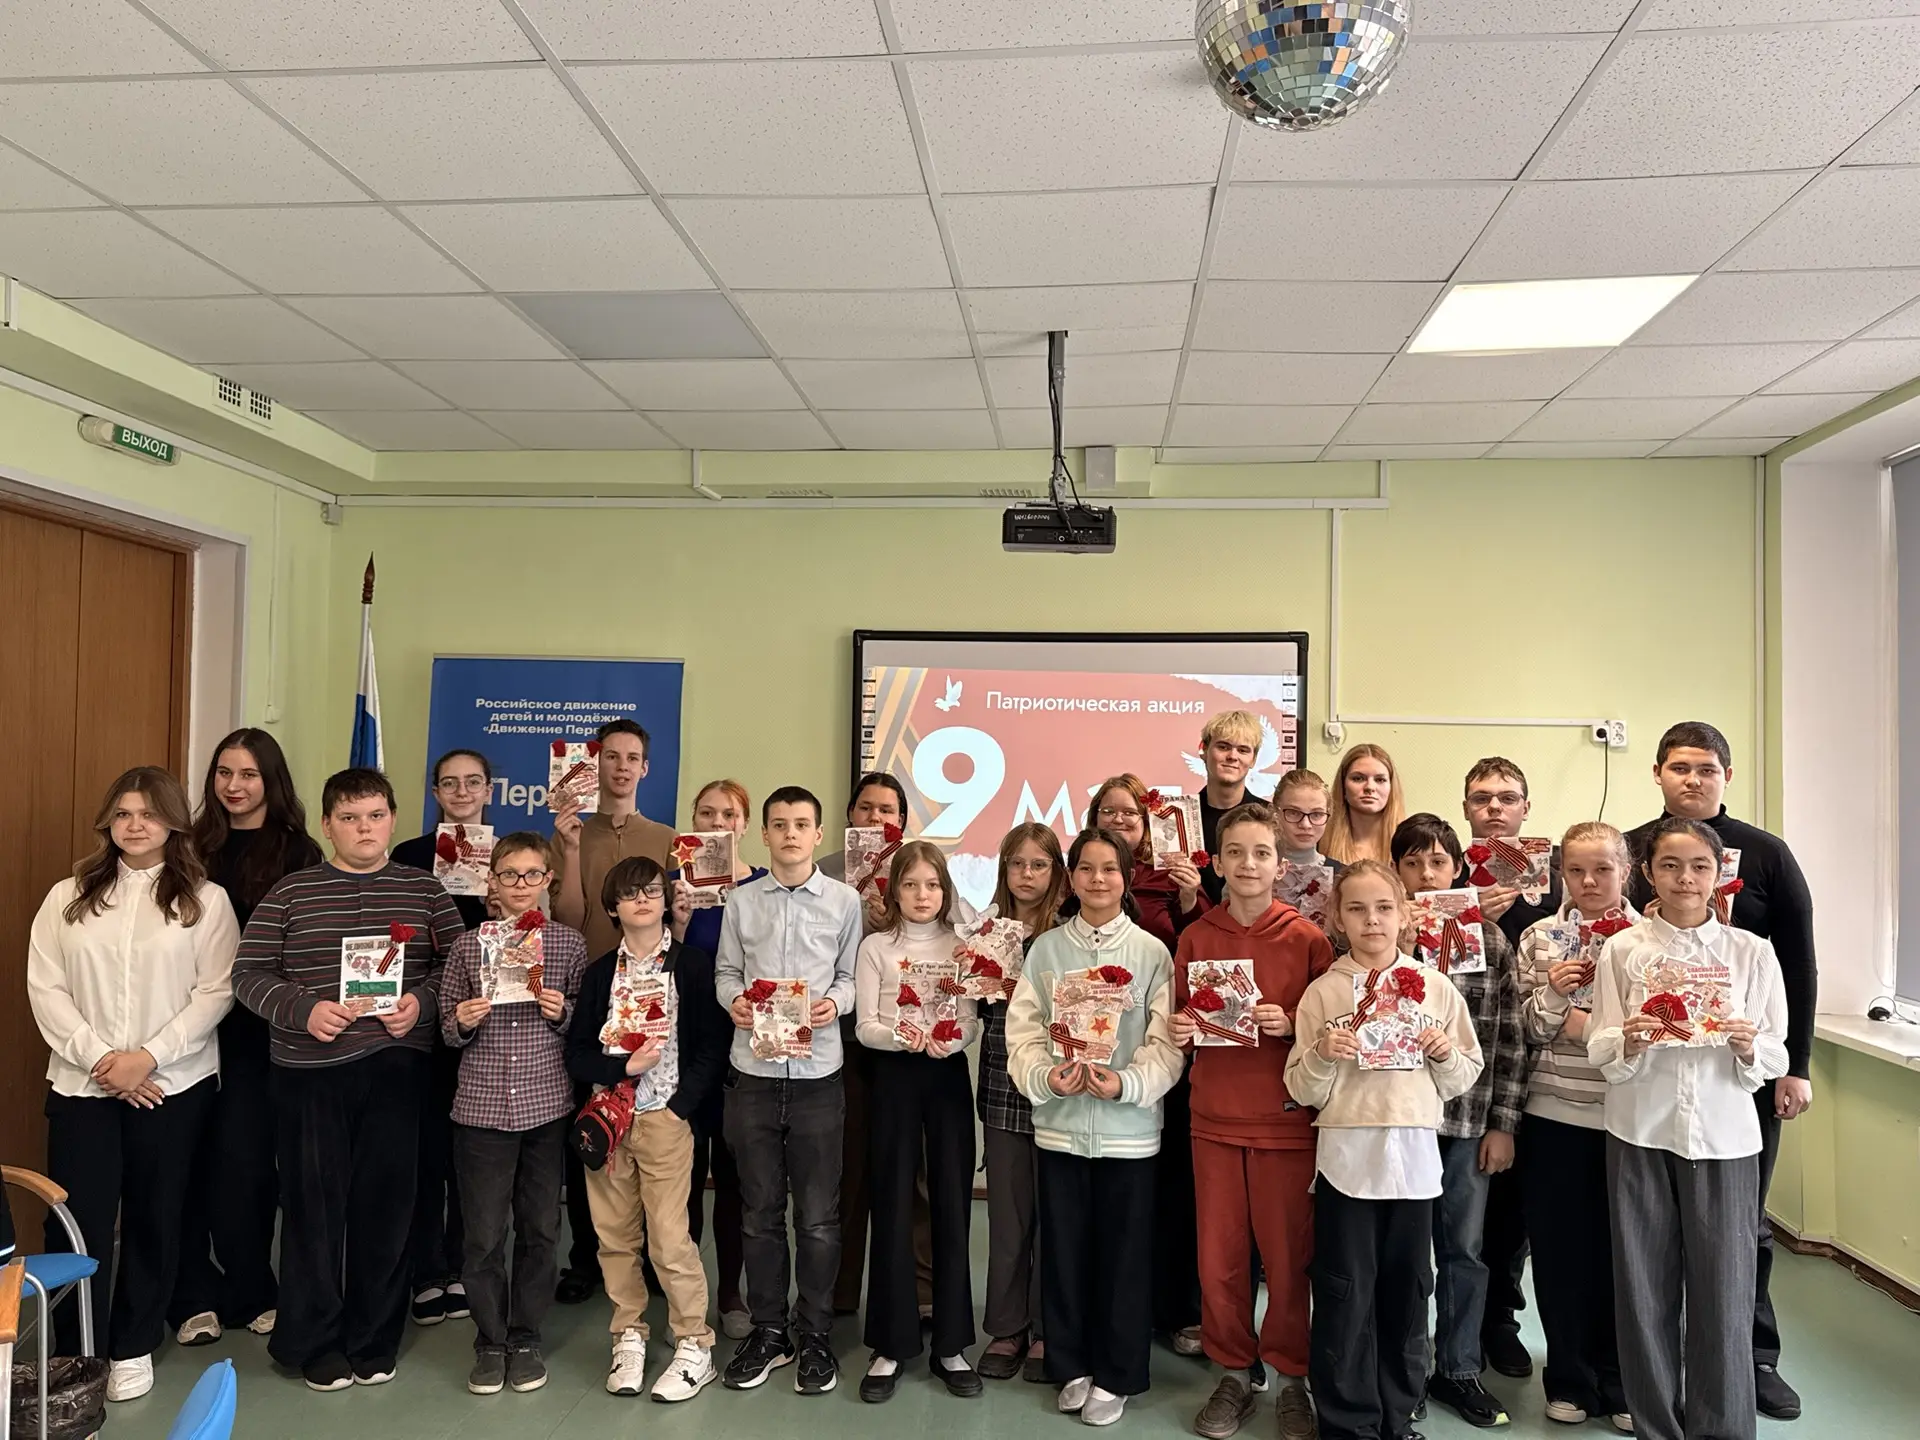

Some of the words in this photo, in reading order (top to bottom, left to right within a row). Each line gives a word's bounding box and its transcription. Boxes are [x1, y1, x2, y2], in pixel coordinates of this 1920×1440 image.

[121, 428, 168, 459] ВЫХОД
[475, 698, 561, 709] Российское
[563, 701, 637, 711] движение
[986, 691, 1141, 714] Патриотическая
[1147, 699, 1205, 715] акция
[482, 723, 563, 734] «Движение
[490, 711, 533, 722] детей
[535, 713, 544, 721] и
[546, 712, 621, 723] молодёжи
[911, 726, 1006, 838] 9
[485, 777, 548, 816] Пер
